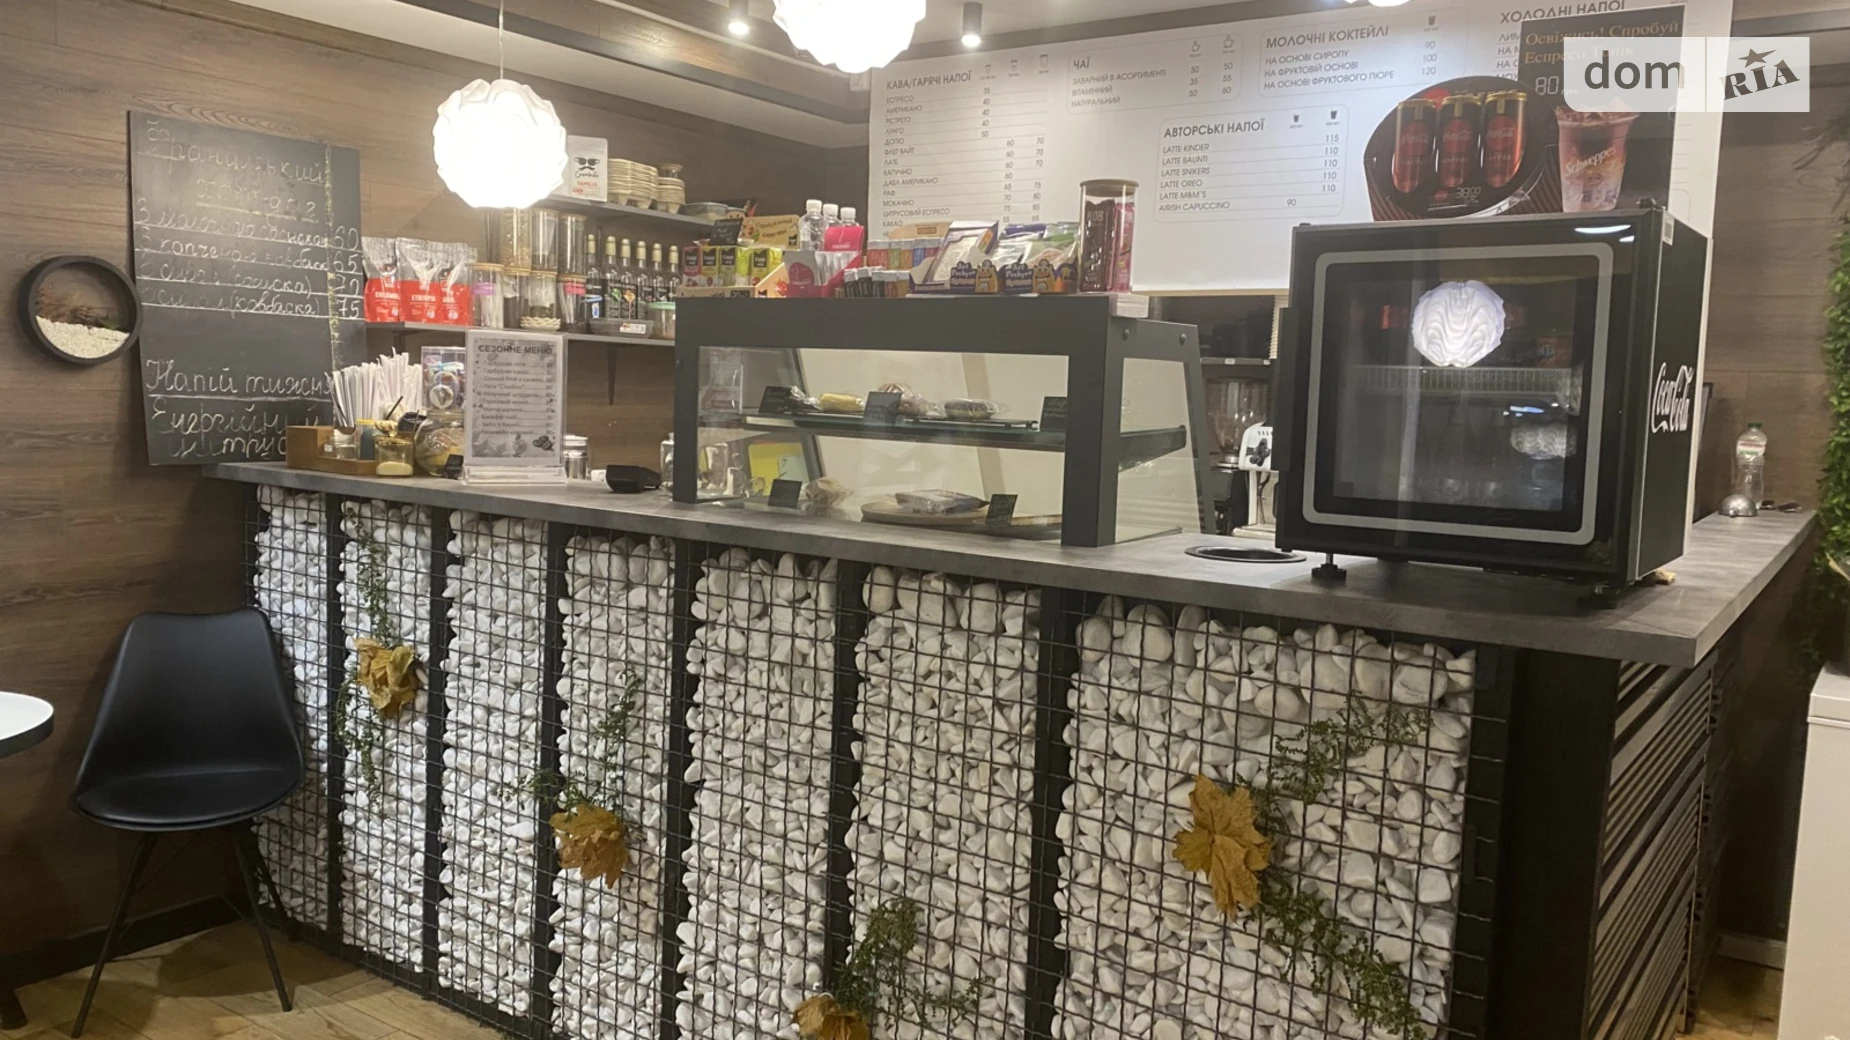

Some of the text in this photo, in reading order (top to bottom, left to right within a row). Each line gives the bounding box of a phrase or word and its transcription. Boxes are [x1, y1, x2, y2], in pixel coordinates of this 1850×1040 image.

[1266, 25, 1389, 49] МОЛОЧНІ КОКТЕЙЛІ
[1265, 41, 1436, 65] НА ОСНОВІ СИРОПУ 90
[1073, 56, 1090, 70] ЧАЇ
[1116, 69, 1167, 81] АСОРТИМЕНТІ
[1190, 66, 1199, 74] 30
[1223, 62, 1233, 70] 50
[1264, 54, 1437, 78] НА ФРУКТОВІЙ ОСНОВІ 100
[886, 70, 972, 90] КАВА/ГАРЯЧІ НАПОЇ
[1189, 78, 1198, 86] 35
[1222, 75, 1232, 83] 55
[1264, 67, 1437, 90] НА ОСНОВІ ФРУКТОВОГО ПЮРЕ 120
[1535, 75, 1559, 95] 80
[1189, 89, 1198, 98] 50
[1221, 87, 1231, 95] 60
[1163, 118, 1266, 139] АВТОРСЬКІ НАПОЇ
[1006, 139, 1015, 147] 60
[1162, 134, 1340, 154] LATTE KINDER 115
[1005, 150, 1014, 158] 60
[1162, 147, 1339, 165] LATTE BAUNTI 110
[1565, 145, 1617, 175] Schweppes
[1005, 161, 1013, 169] 60
[1161, 159, 1338, 177] LATTE SNIKERS 110
[1004, 172, 1013, 180] 60
[1160, 172, 1337, 189] LATTE OREO 110
[1003, 194, 1011, 202] 70
[1159, 192, 1179, 201] LATTE
[1322, 184, 1336, 193] 110
[1159, 198, 1297, 212] AIRISH CAPUCCINO 90
[334, 225, 359, 251] 60
[333, 250, 359, 273] 65
[334, 297, 360, 320] 75
[478, 344, 553, 355] СЕЗОННЕ МЕНЮ
[145, 358, 238, 394] Напій
